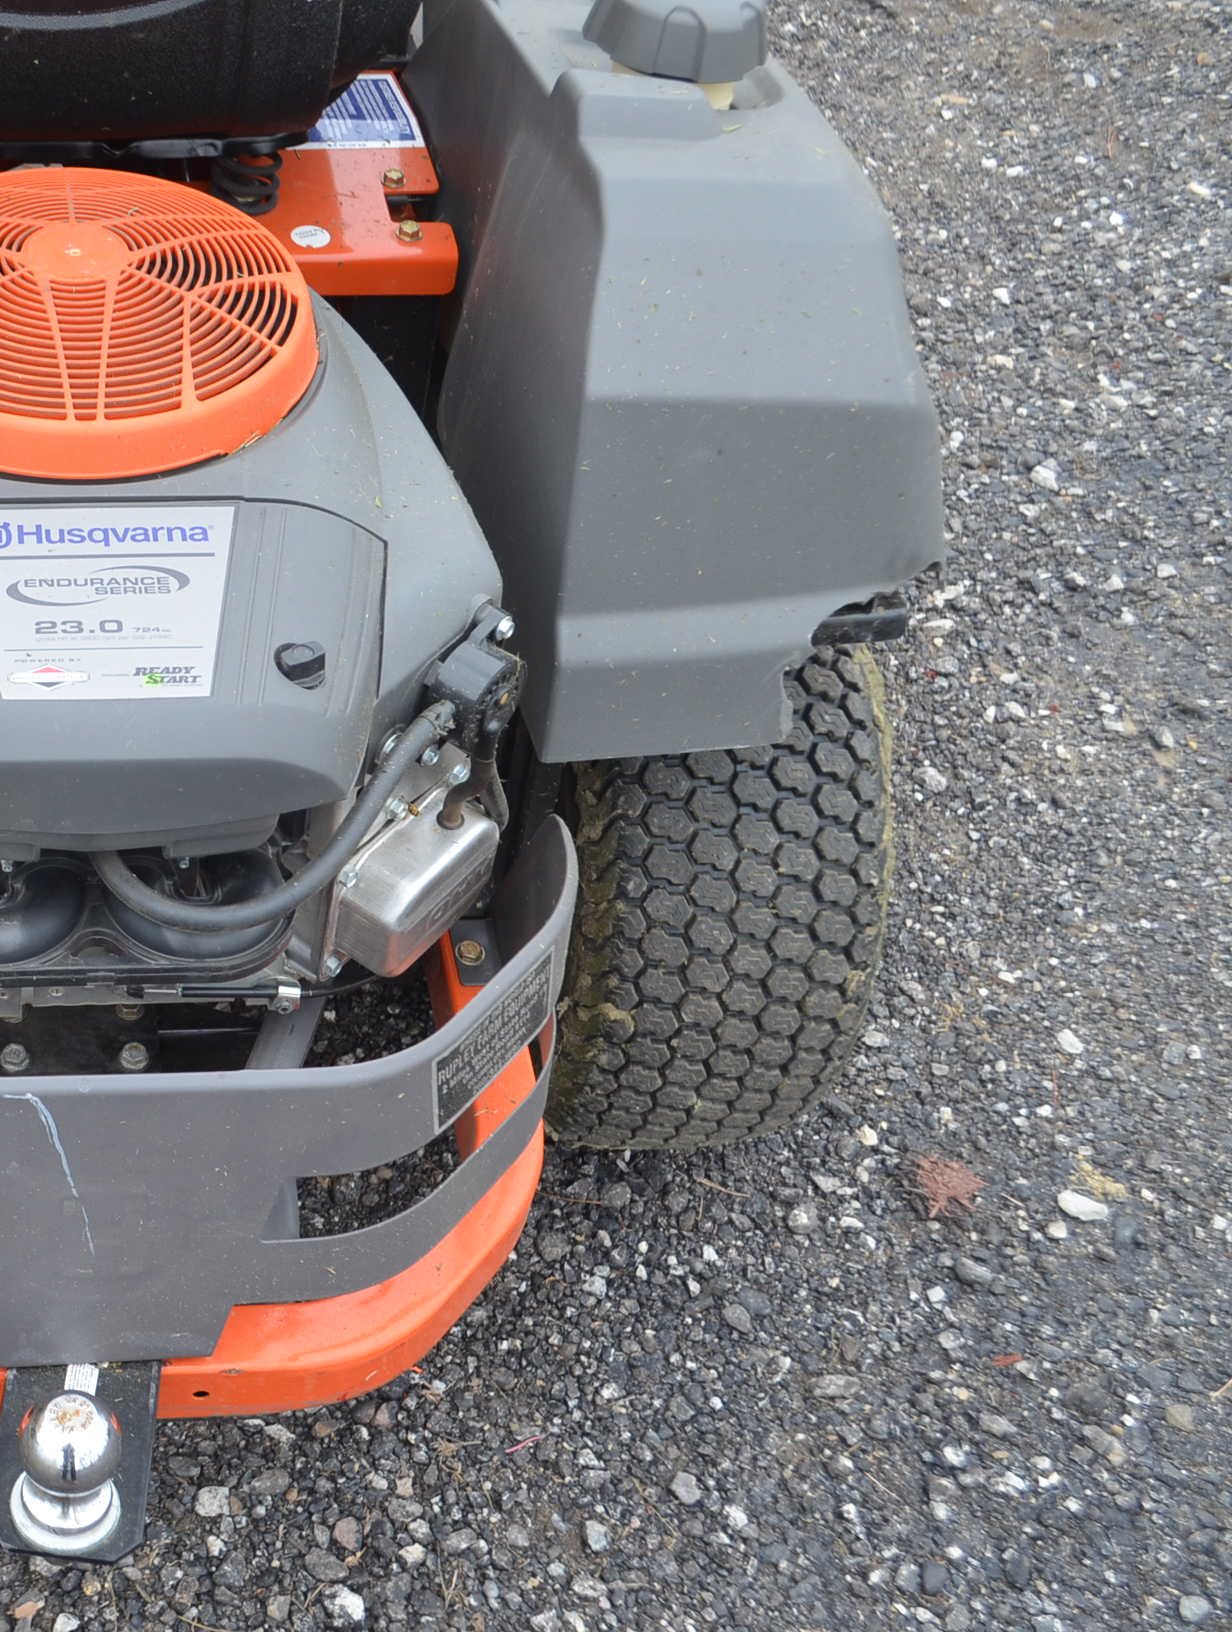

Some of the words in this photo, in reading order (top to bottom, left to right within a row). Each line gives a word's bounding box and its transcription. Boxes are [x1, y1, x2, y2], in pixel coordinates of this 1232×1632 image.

[17, 524, 209, 547] Husqvarna
[23, 576, 170, 588] ENDURANCE
[94, 585, 172, 595] SERIES
[34, 619, 124, 634] 23.0
[133, 666, 195, 676] READY
[145, 673, 202, 685] START
[438, 1043, 475, 1087] RUPLEY
